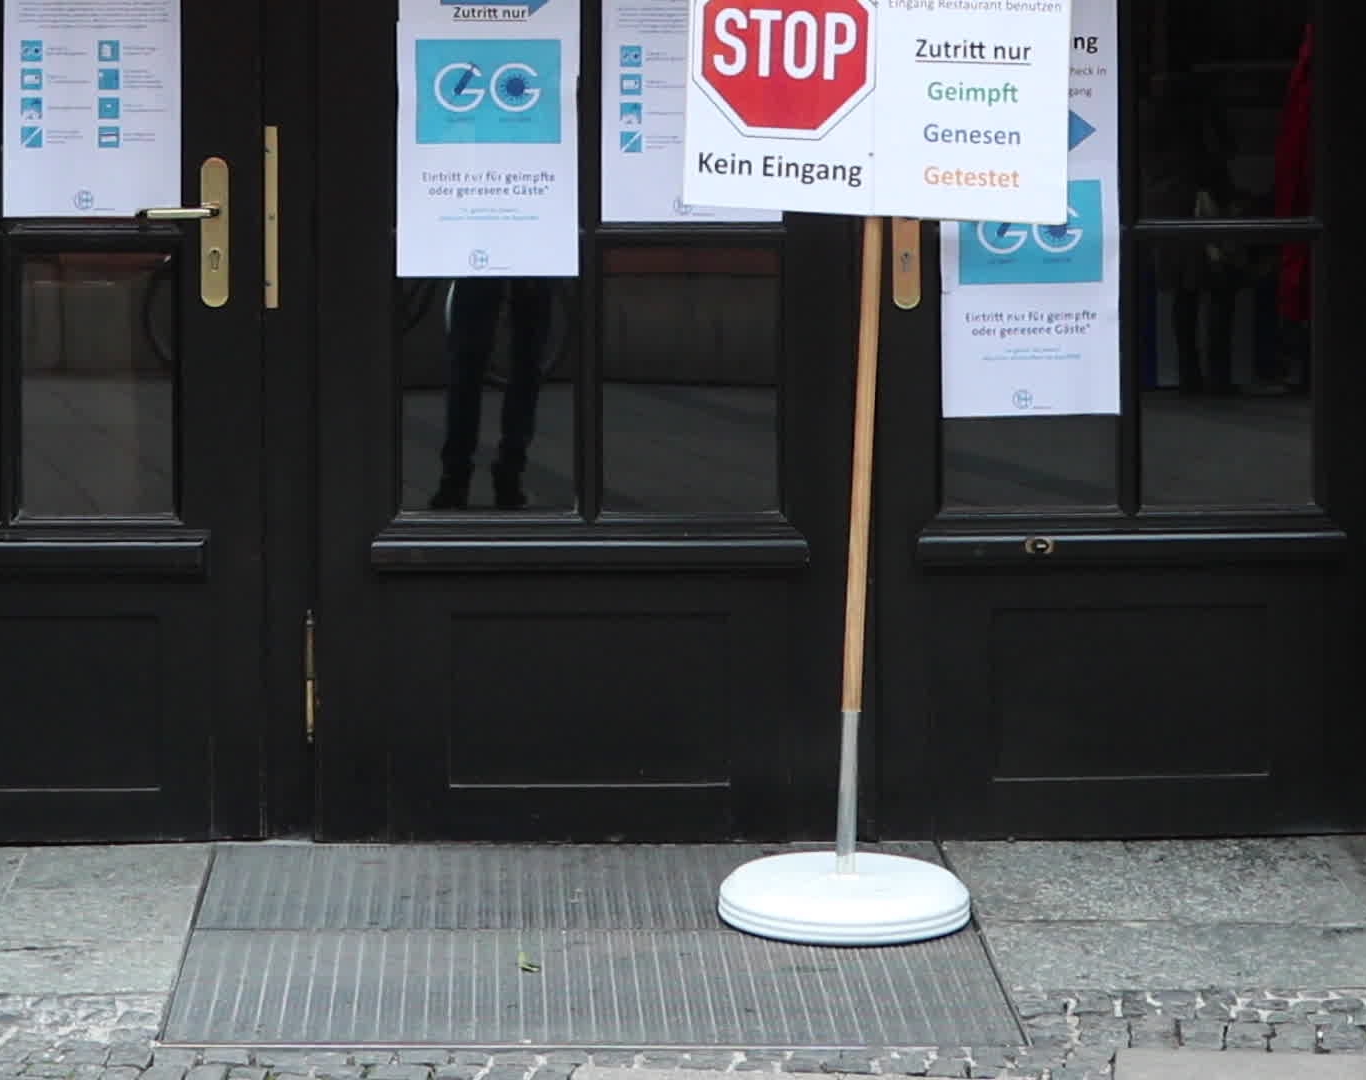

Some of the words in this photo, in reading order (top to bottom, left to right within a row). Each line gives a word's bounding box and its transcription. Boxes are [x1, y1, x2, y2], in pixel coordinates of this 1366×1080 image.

[453, 6, 498, 19] Zutritt
[502, 8, 526, 19] nur
[713, 8, 857, 81] STOP
[915, 39, 985, 60] Zutritt
[993, 46, 1032, 61] nur
[927, 81, 1019, 106] Geimpft
[923, 124, 1021, 146] Genesen
[422, 171, 461, 182] Eintritt
[464, 172, 484, 182] nur
[486, 171, 502, 182] für
[505, 171, 555, 186] geimpfte
[698, 151, 753, 177] Kein
[762, 156, 862, 187] Eingang
[924, 166, 1020, 189] Getestet
[428, 186, 453, 197] oder
[456, 187, 509, 199] genesene
[965, 311, 1004, 323] Eintritt
[1007, 313, 1026, 323] nur
[1028, 311, 1044, 322] für
[1047, 310, 1097, 325] geimpfte
[971, 326, 997, 337] oder
